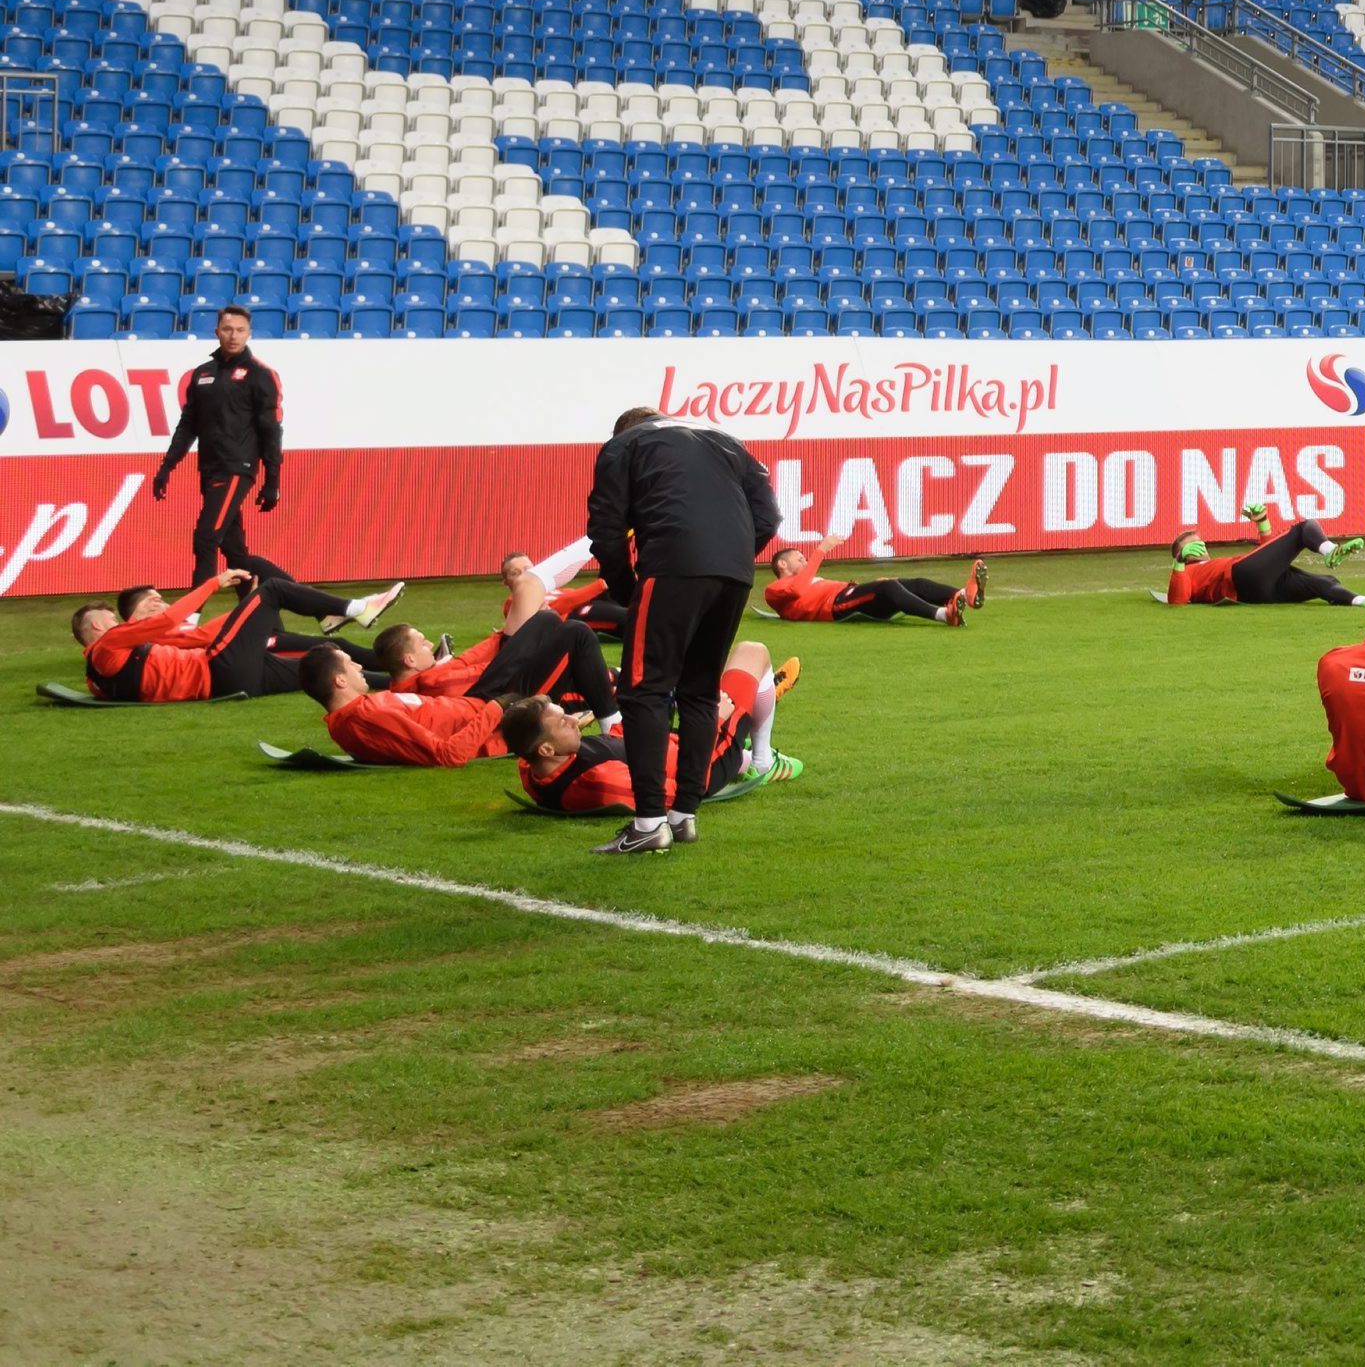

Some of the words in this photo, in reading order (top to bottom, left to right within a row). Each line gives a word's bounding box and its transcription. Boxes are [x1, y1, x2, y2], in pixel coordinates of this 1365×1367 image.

[26, 368, 197, 440] LOT
[1042, 449, 1158, 533] DO
[1180, 443, 1347, 525] NAS
